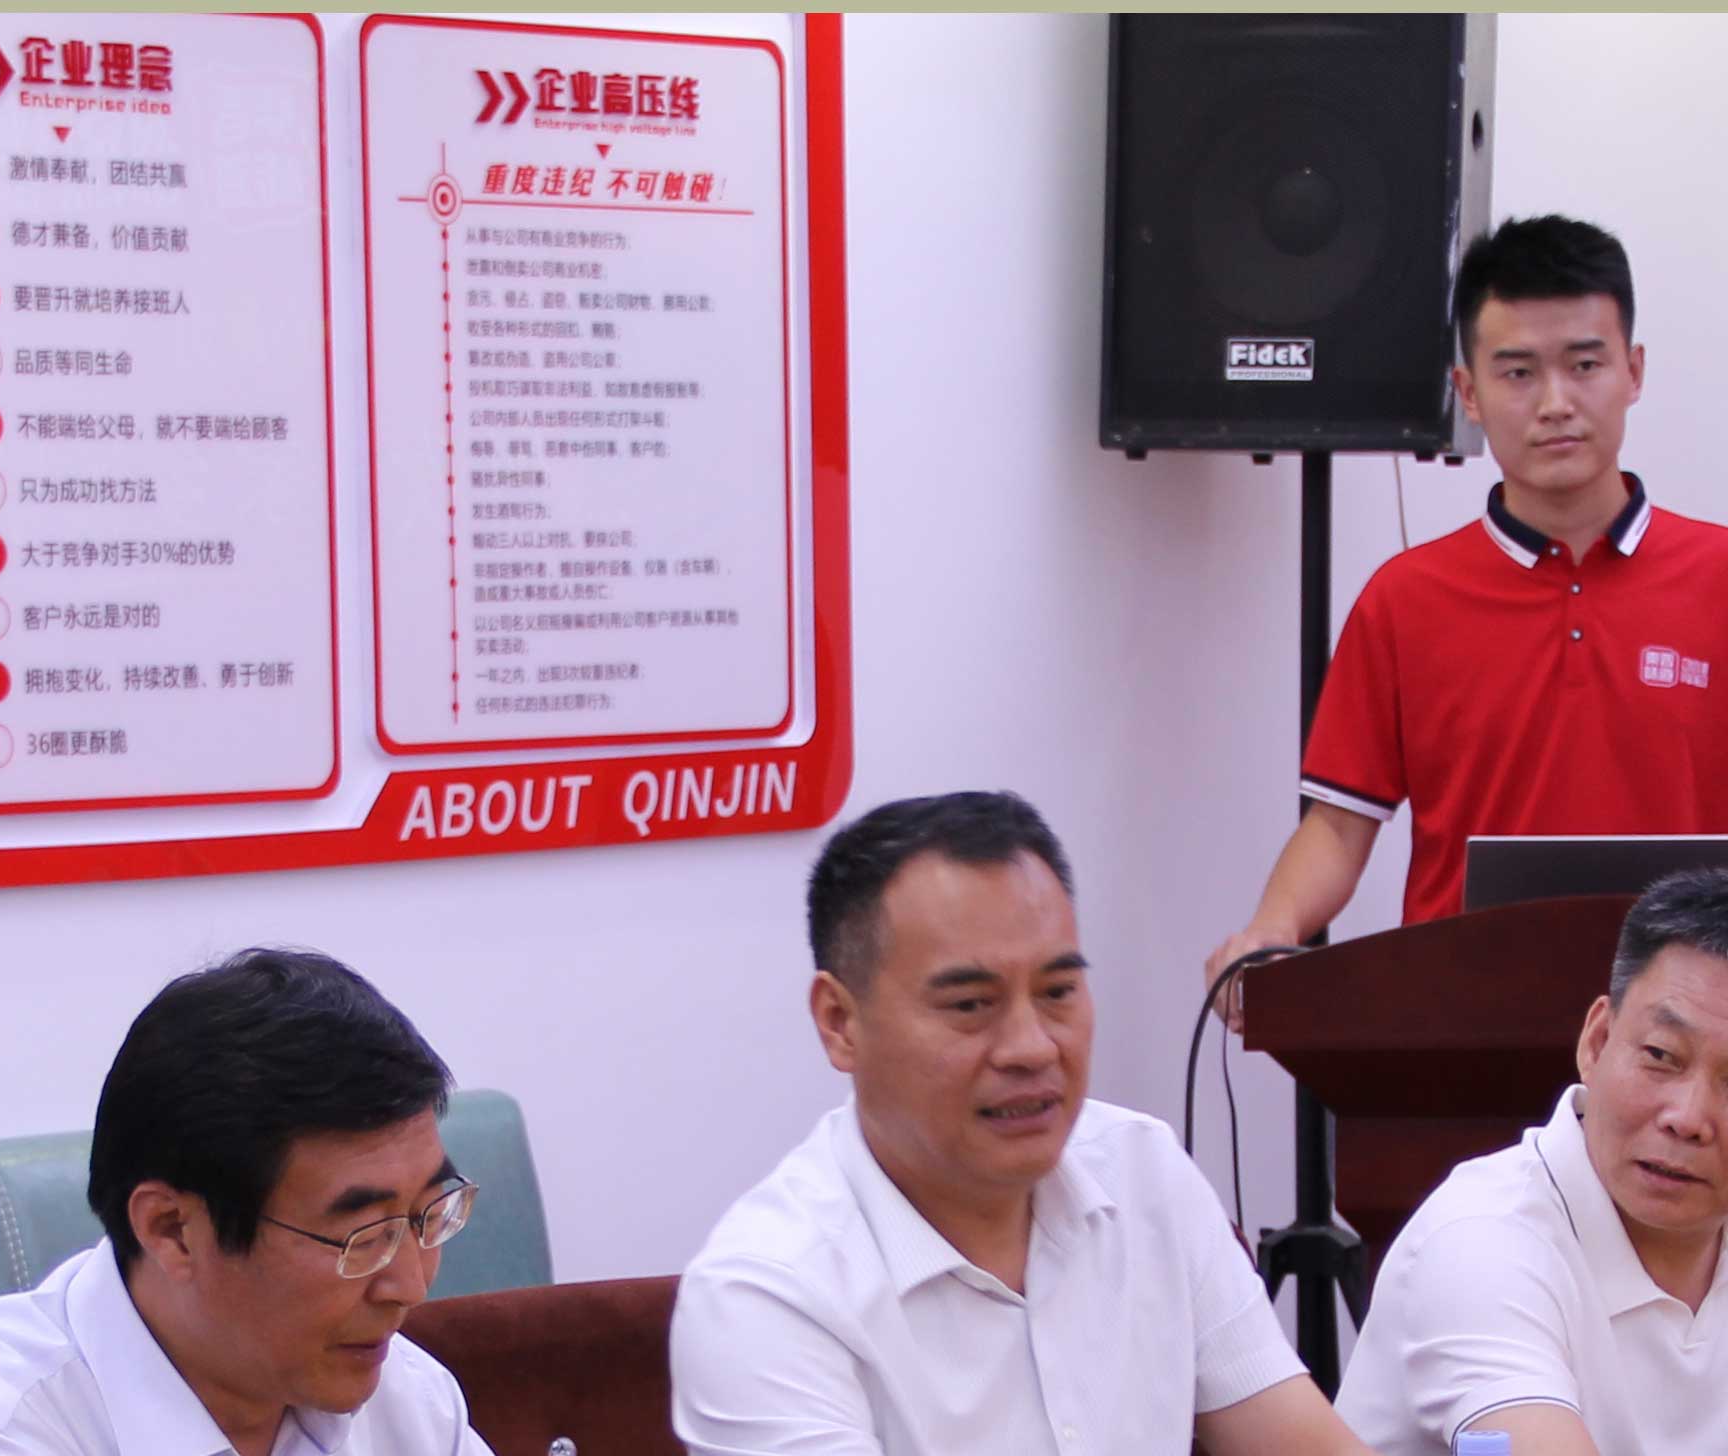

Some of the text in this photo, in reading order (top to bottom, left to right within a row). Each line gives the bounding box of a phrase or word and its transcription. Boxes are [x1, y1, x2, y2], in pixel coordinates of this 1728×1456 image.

[19, 37, 174, 92] 企业理念
[19, 91, 171, 115] Enterprise idea
[534, 68, 700, 120] 企业高压线
[481, 164, 597, 197] 重度违纪
[13, 285, 191, 315] 要晋升就培养接班人
[15, 348, 133, 375] 品质等同生命
[19, 478, 157, 504] 只为成功找方法
[22, 541, 236, 568] 大于竞争对手30%的优势
[23, 605, 160, 631] 客户永远是对的
[27, 730, 128, 756] 36圈更酥脆
[399, 761, 797, 842] ABOUT QINJIN
